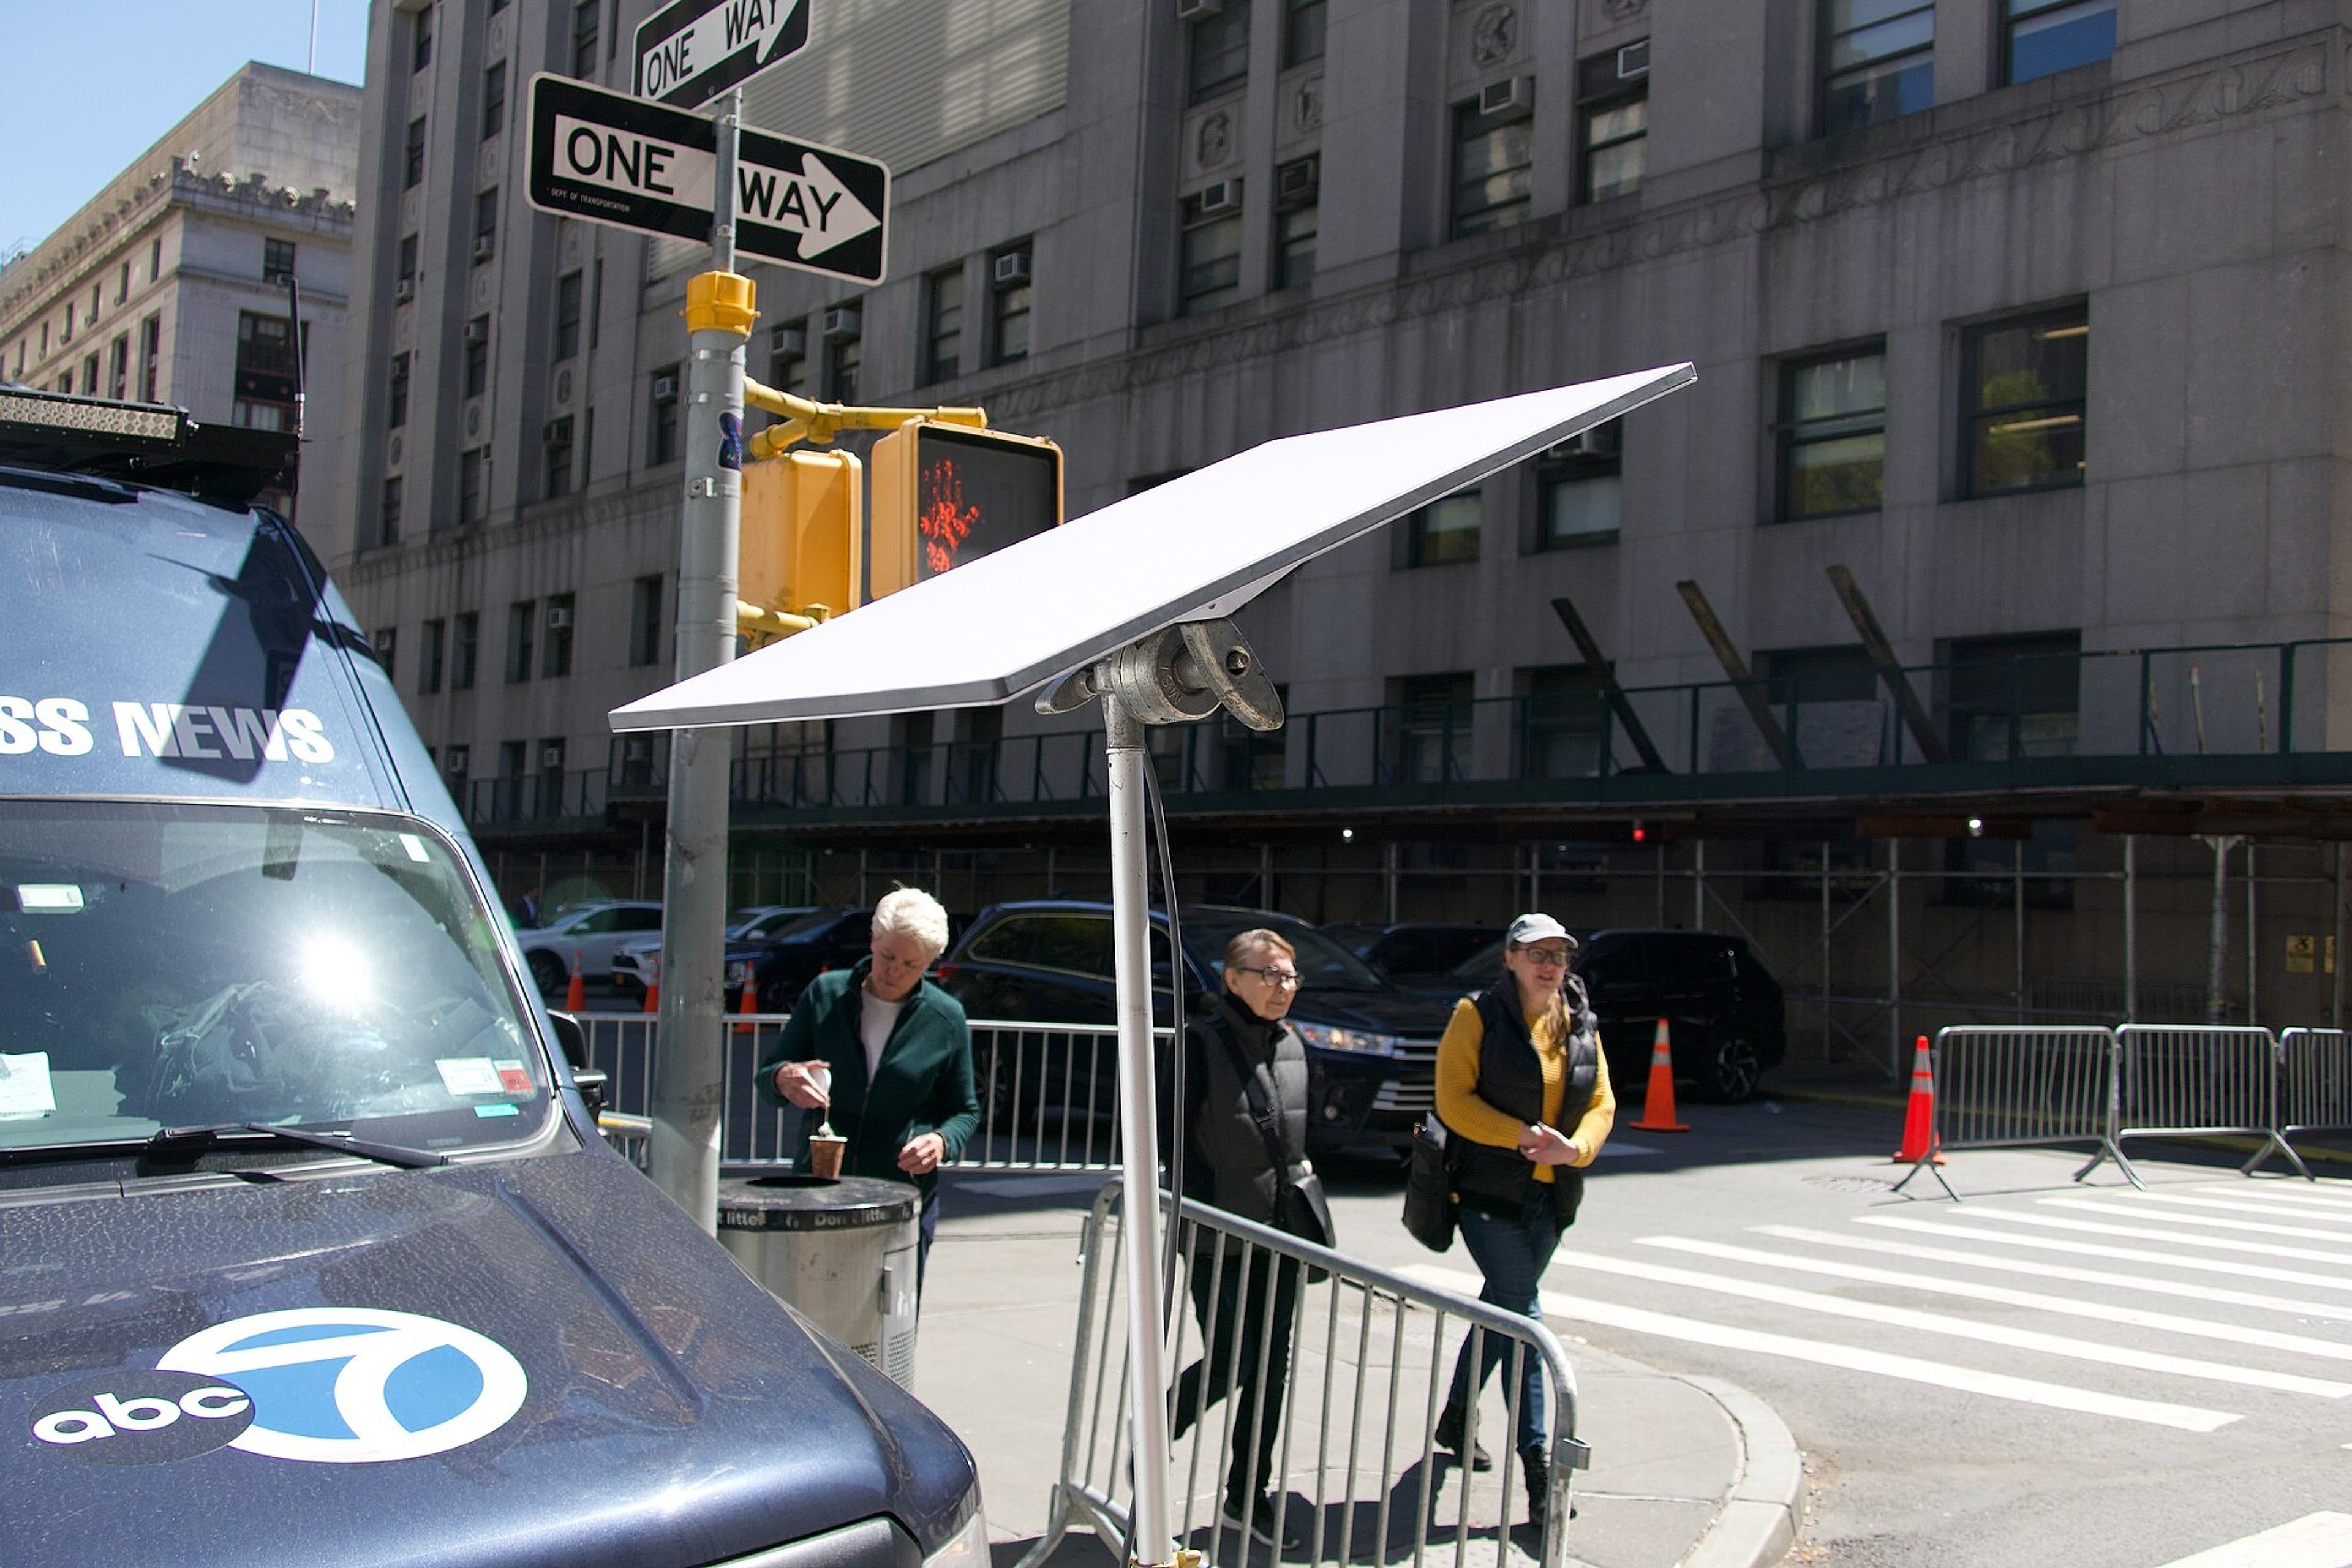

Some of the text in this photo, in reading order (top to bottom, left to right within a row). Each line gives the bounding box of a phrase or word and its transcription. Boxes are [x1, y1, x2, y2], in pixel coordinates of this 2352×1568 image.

[647, 28, 695, 96] ONE
[567, 127, 842, 232] ONE WAY
[580, 194, 631, 213] TRANSPORTATION
[111, 701, 336, 764] NEWS
[32, 1387, 251, 1445] abc
